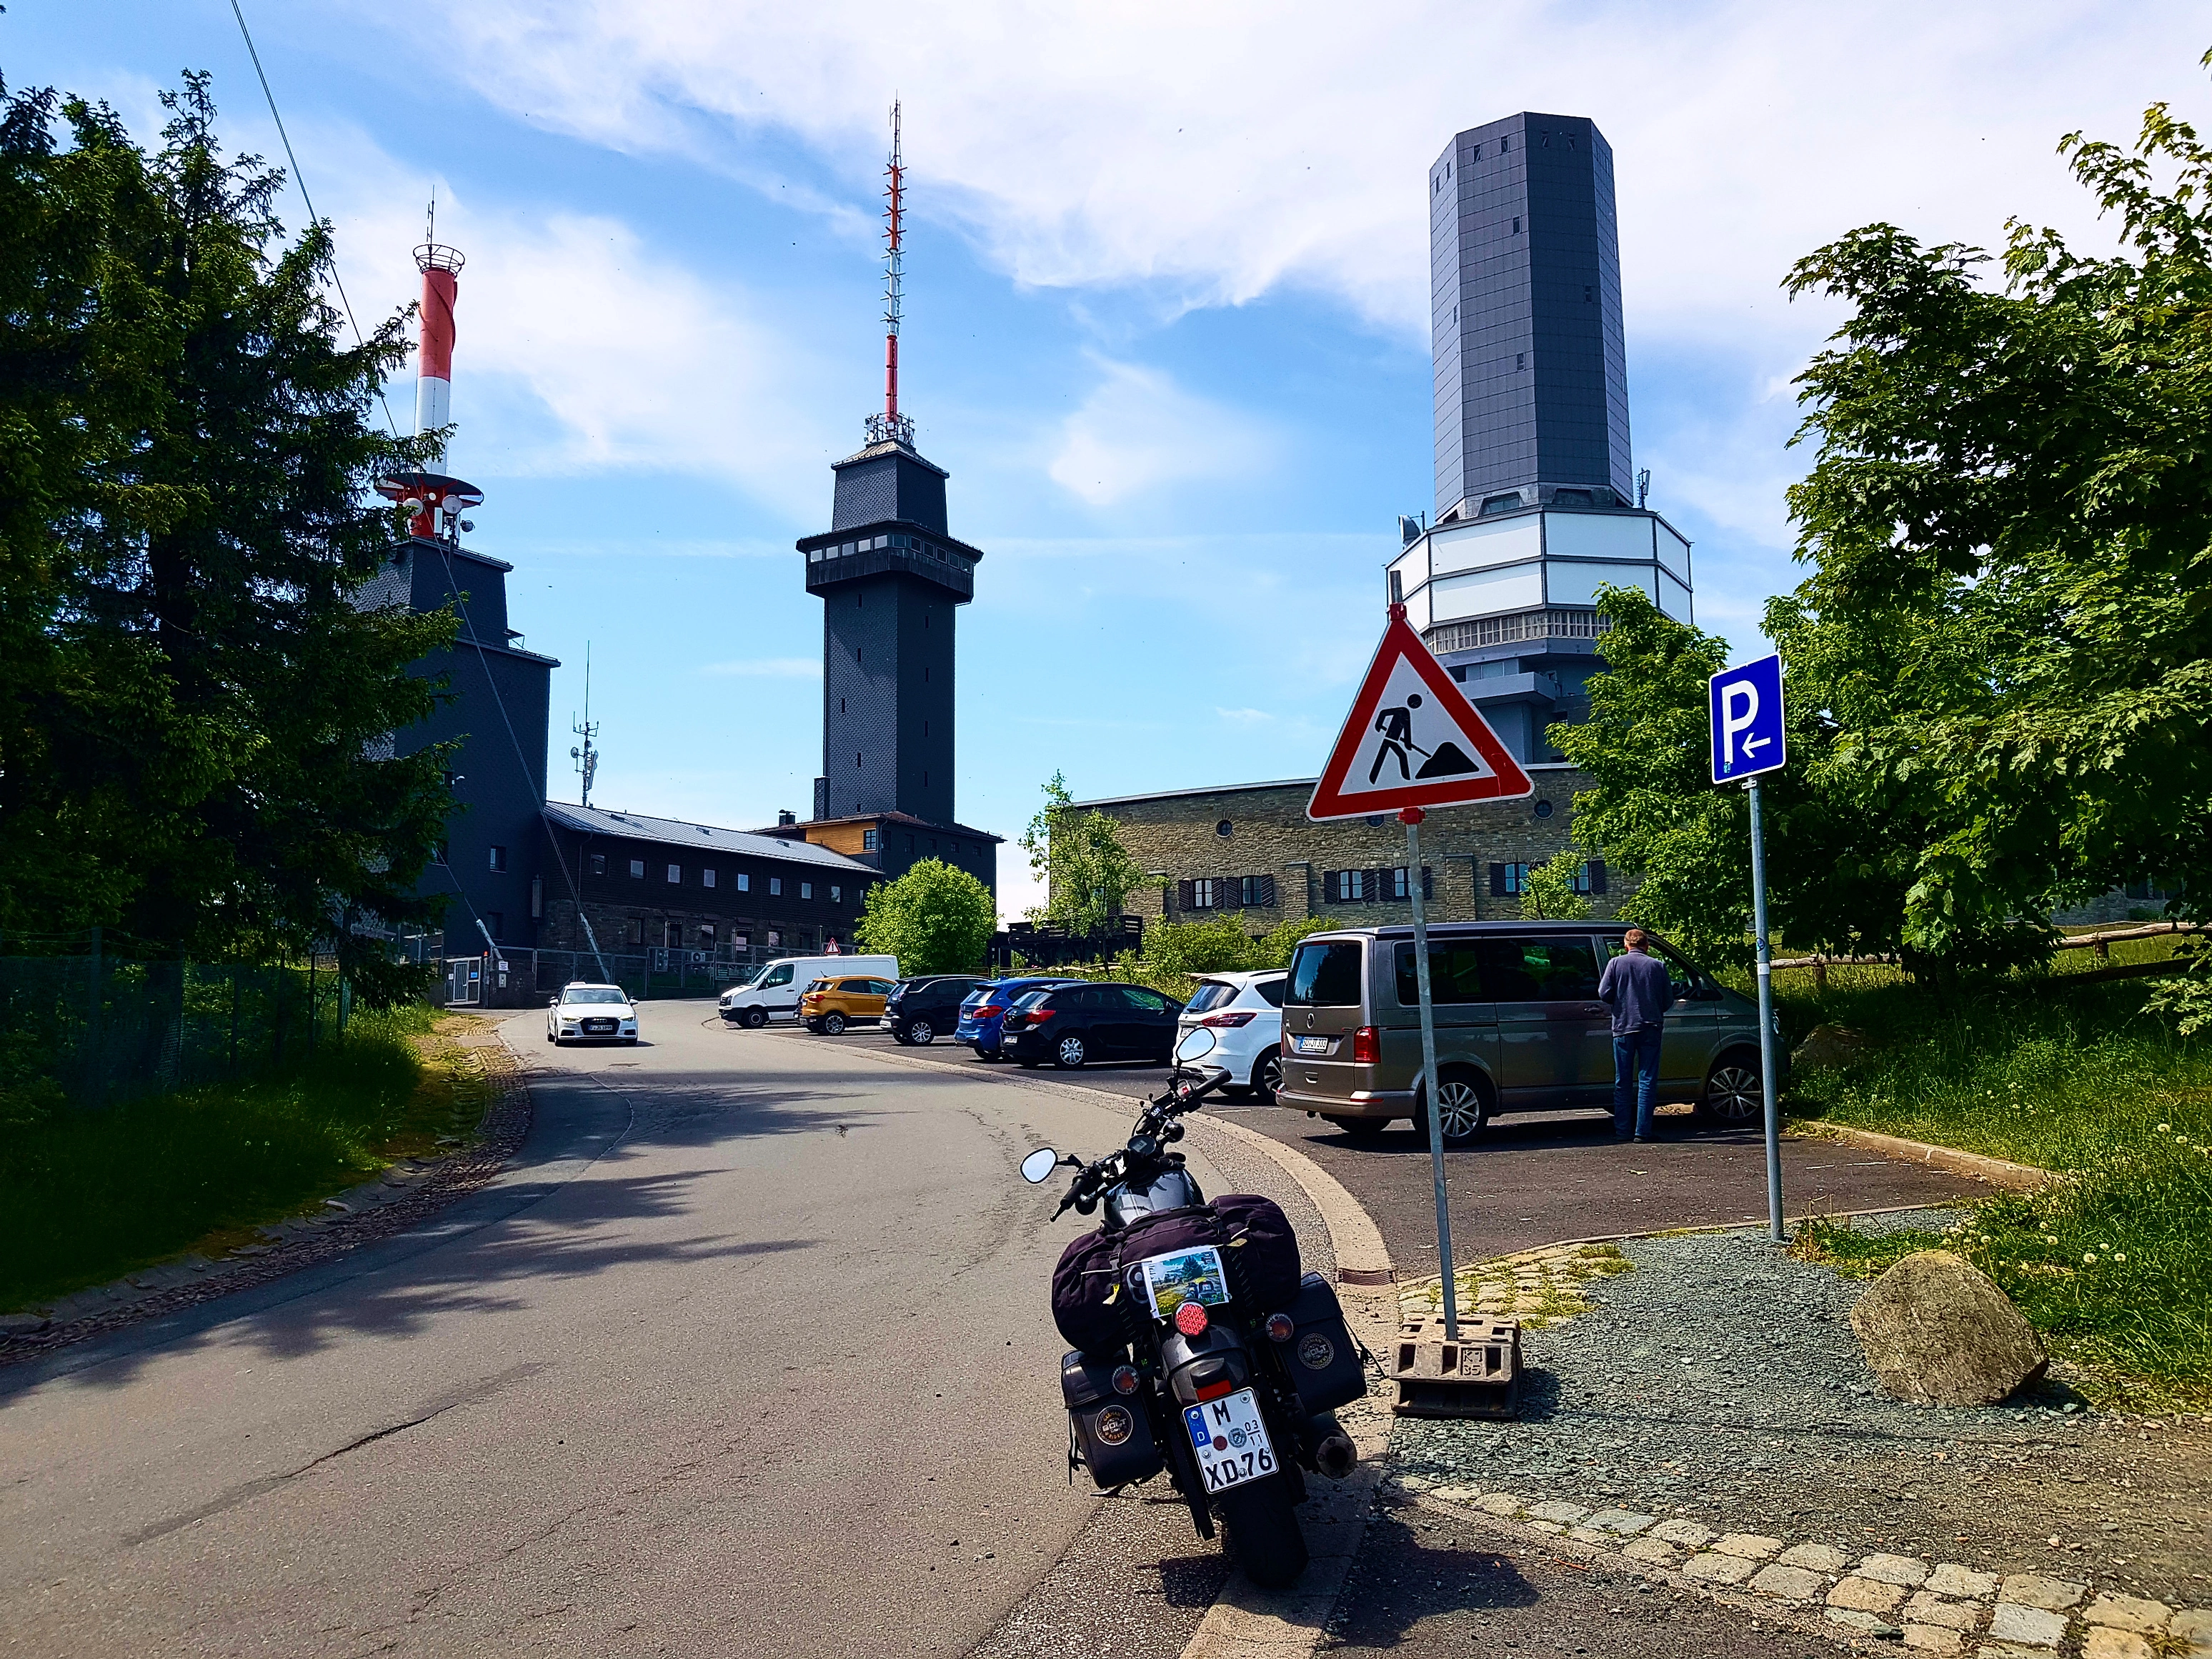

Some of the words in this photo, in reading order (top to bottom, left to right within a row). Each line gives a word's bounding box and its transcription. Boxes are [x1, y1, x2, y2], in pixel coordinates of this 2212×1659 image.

[1722, 680, 1759, 764] P
[1303, 1344, 1327, 1358] BOLT
[1212, 1400, 1231, 1426] M
[1102, 1418, 1127, 1433] BOLT
[1245, 1419, 1259, 1432] 03
[1197, 1431, 1205, 1442] D
[1250, 1434, 1262, 1446] 11
[1240, 1448, 1272, 1477] 76
